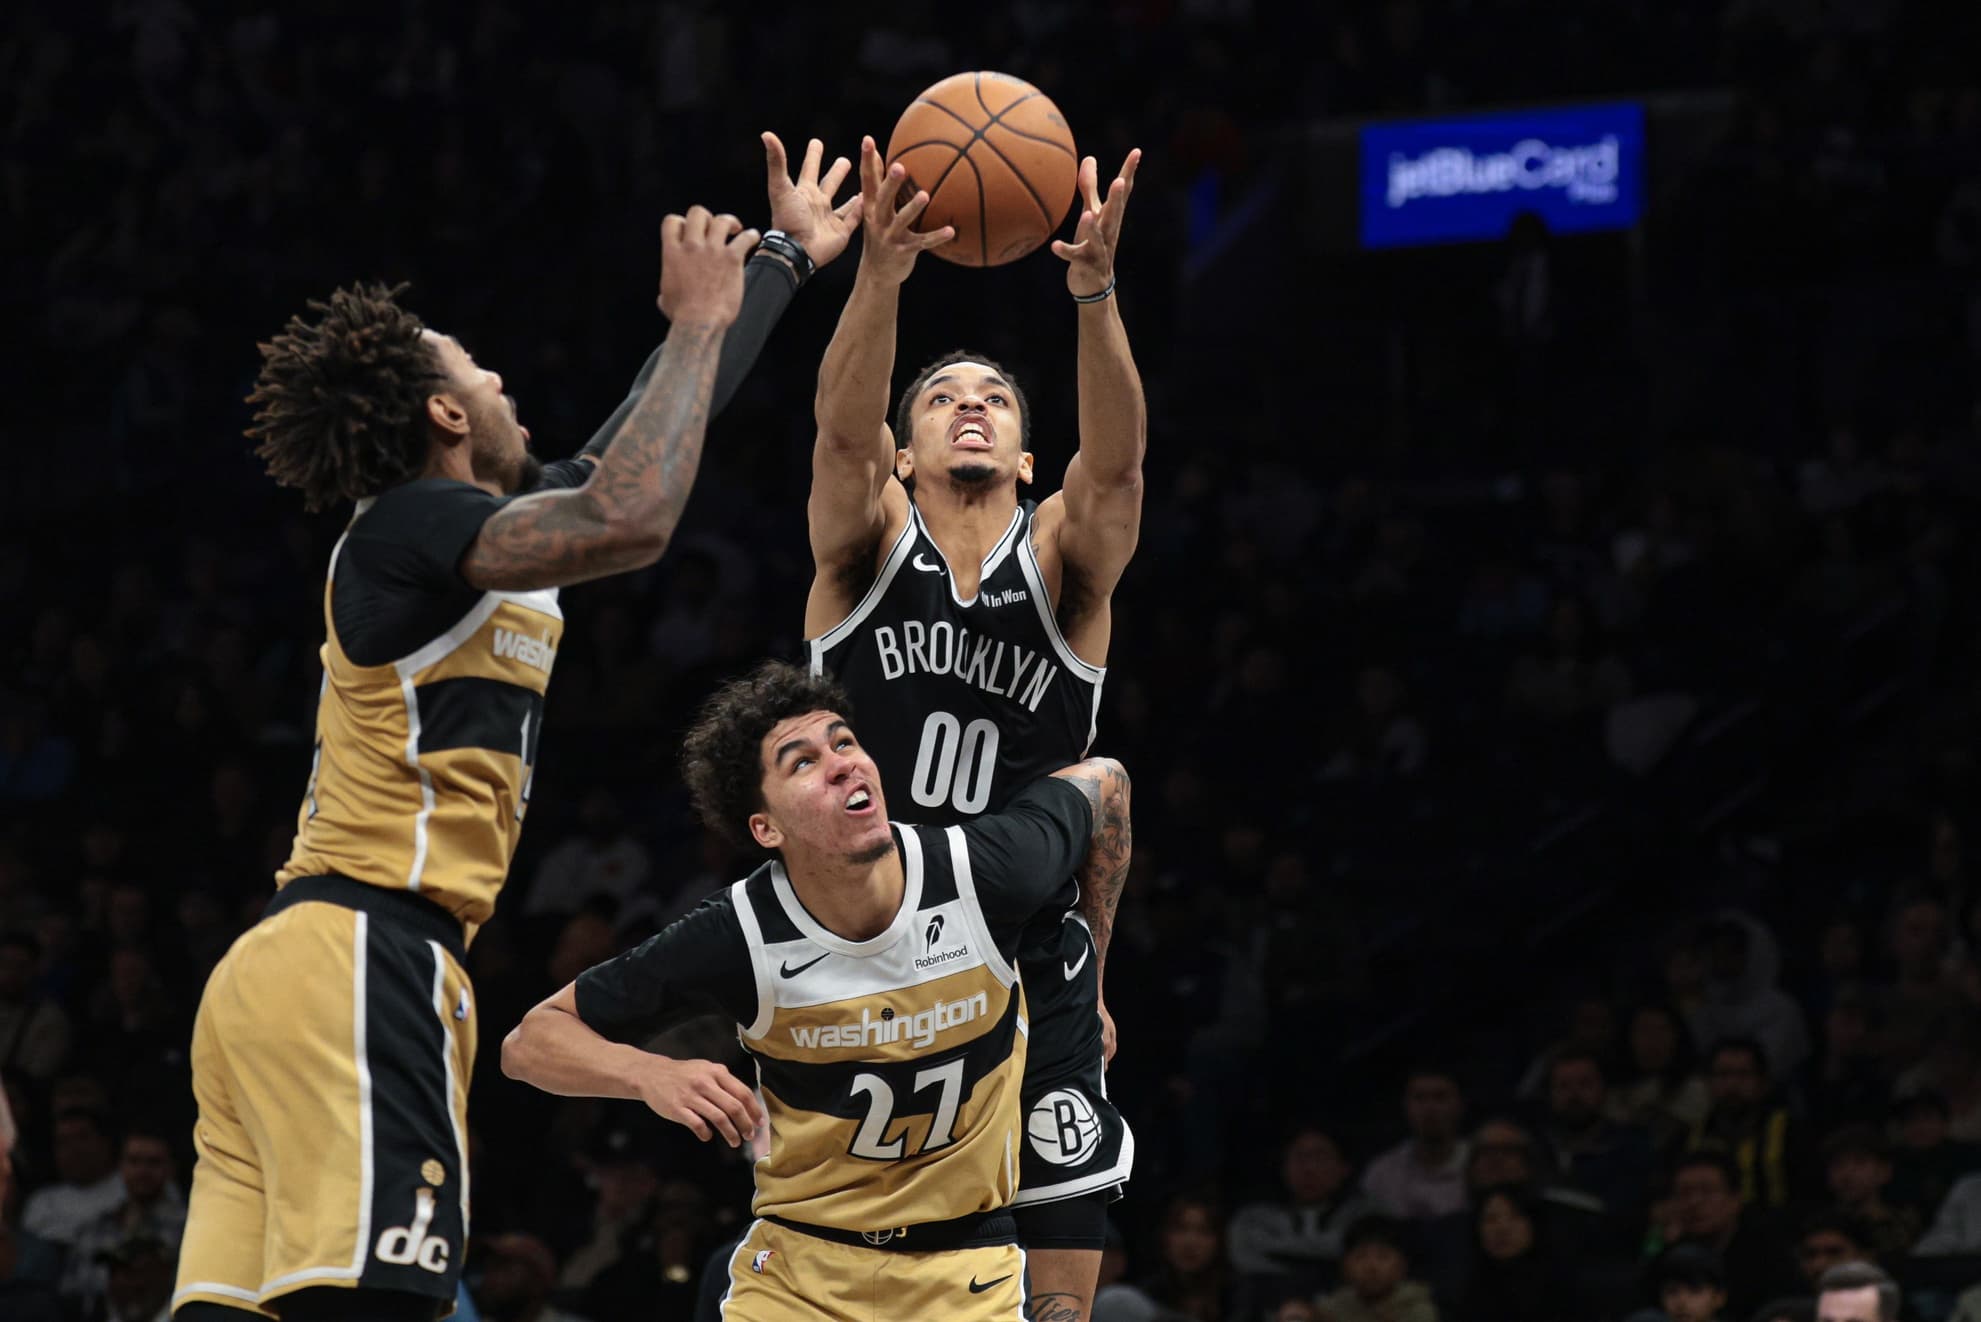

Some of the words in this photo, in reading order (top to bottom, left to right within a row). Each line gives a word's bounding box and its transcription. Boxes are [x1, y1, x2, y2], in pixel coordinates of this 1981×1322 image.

[990, 594, 1002, 608] In
[1001, 588, 1027, 604] Won
[875, 620, 1058, 713] BROOKLYN
[910, 711, 1000, 815] 00
[914, 945, 968, 969] Robinhood
[789, 991, 988, 1050] washington
[847, 1055, 967, 1162] 27
